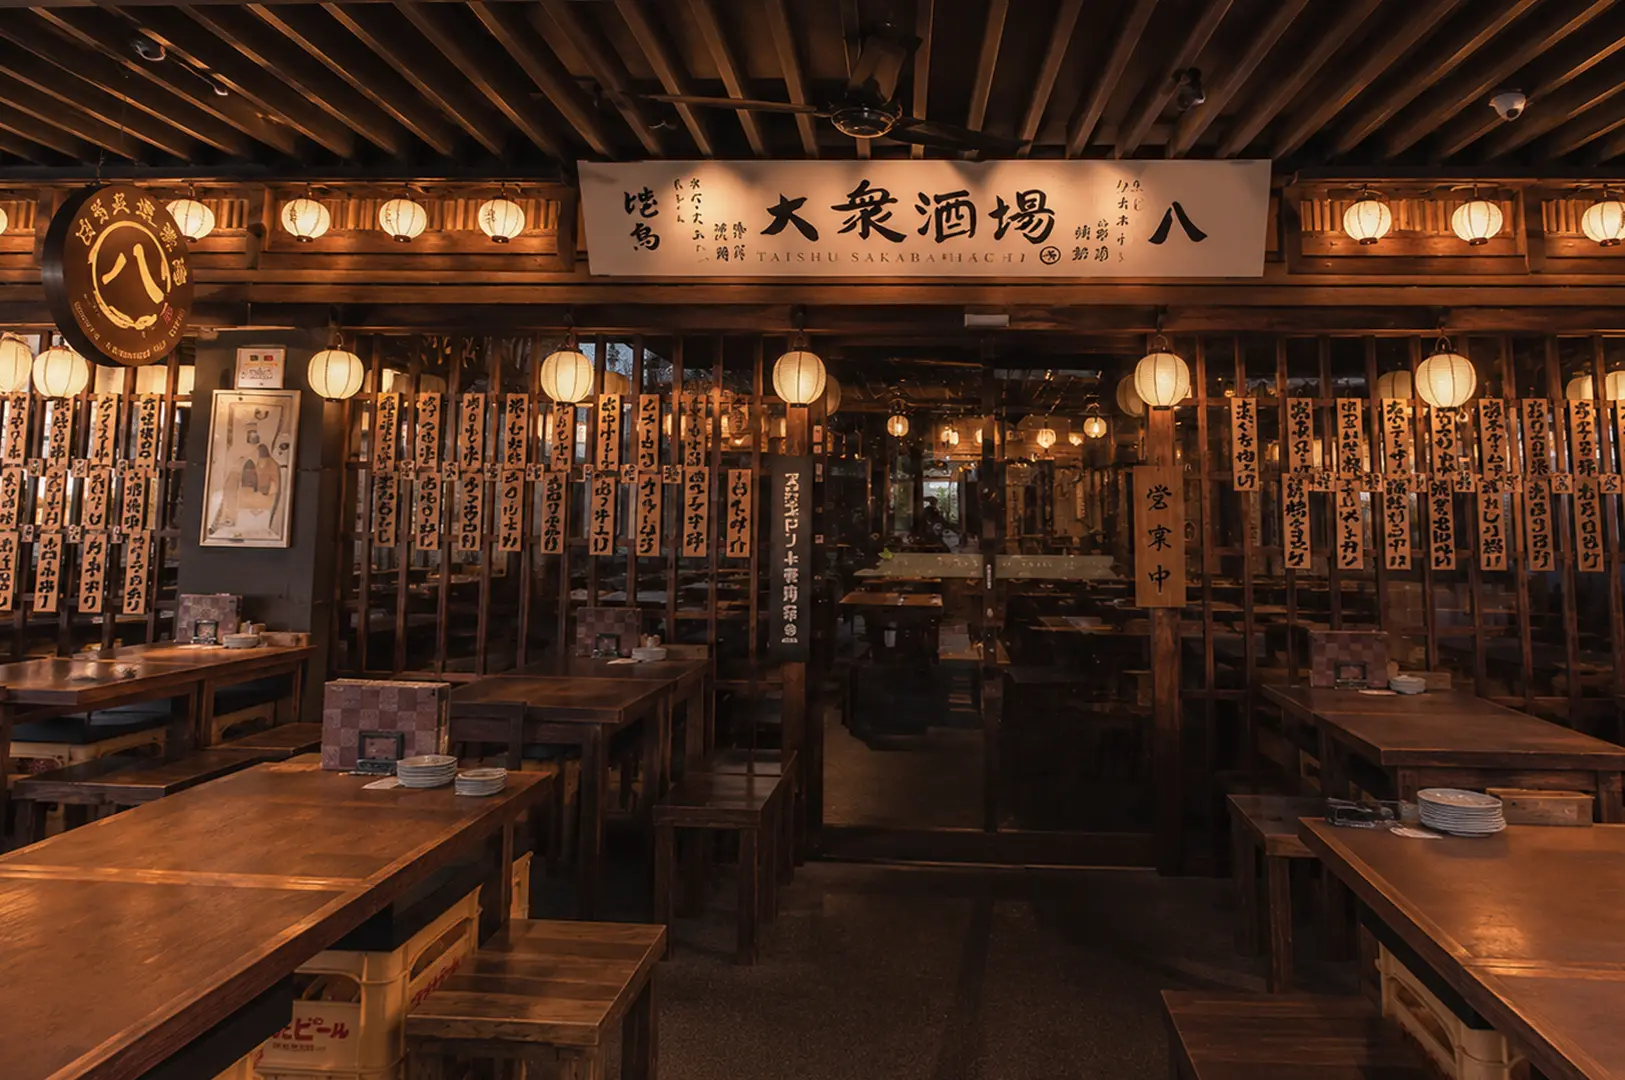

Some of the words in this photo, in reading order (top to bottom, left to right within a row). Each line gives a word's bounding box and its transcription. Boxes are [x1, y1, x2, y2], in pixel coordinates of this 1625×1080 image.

[760, 179, 1056, 245] 大衆酒場
[1147, 200, 1208, 245] 八
[101, 242, 165, 305] 八
[756, 251, 839, 263] TAISHU
[850, 251, 936, 263] SAKABA
